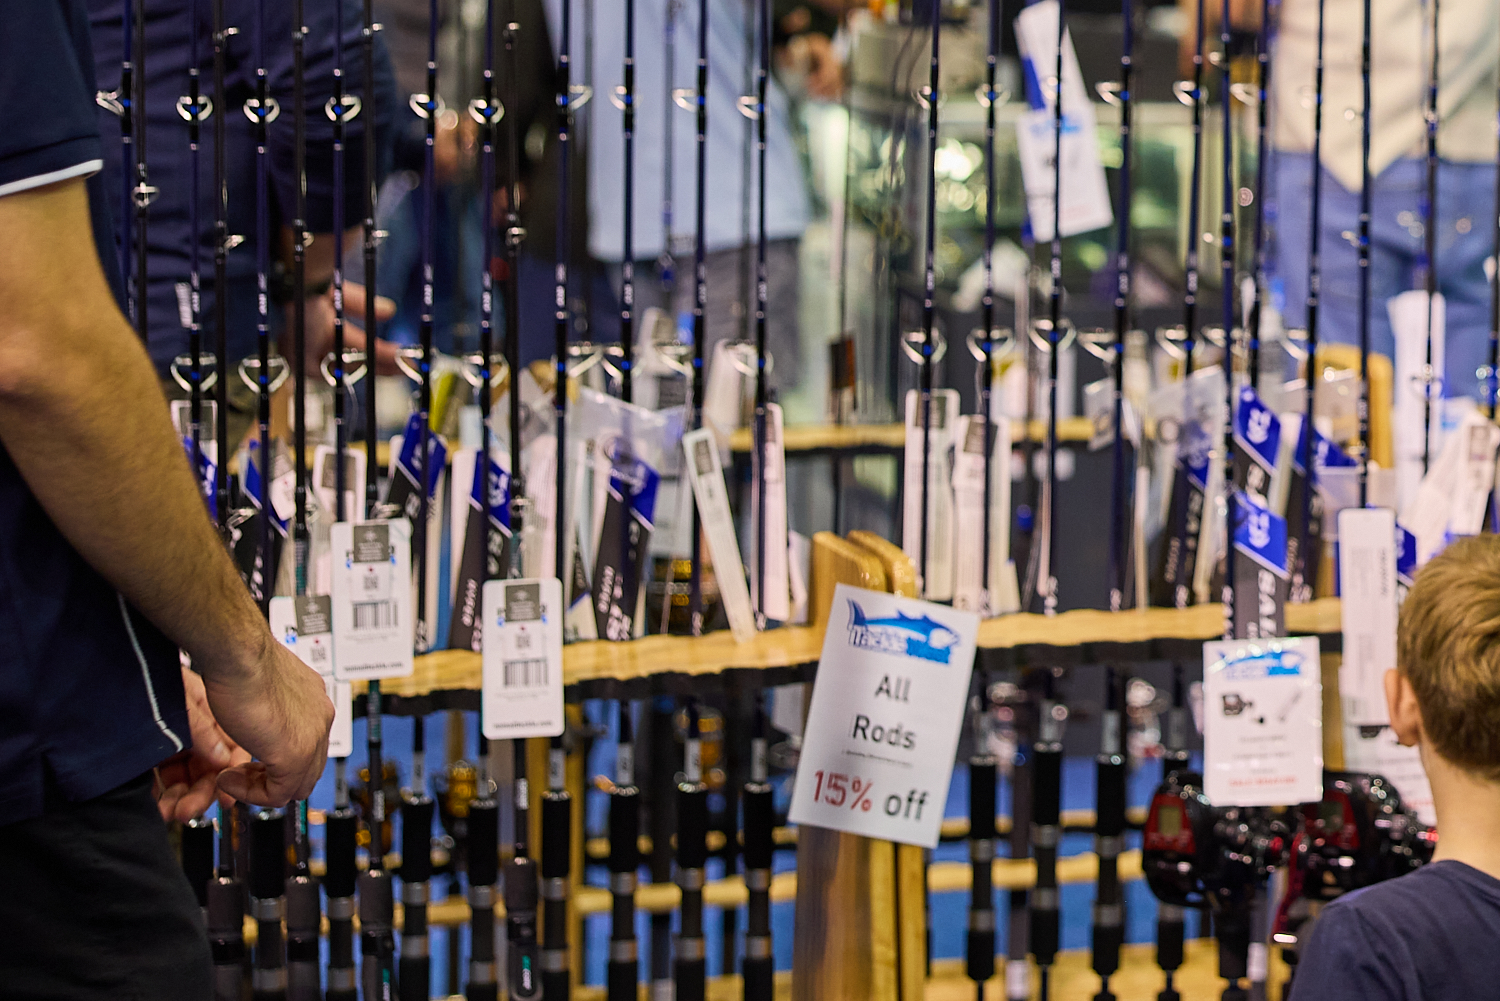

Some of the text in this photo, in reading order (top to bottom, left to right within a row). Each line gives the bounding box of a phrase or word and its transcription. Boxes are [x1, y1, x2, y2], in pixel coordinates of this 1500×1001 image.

[874, 673, 912, 702] All
[853, 714, 916, 750] Rods
[814, 769, 929, 821] 15% off
